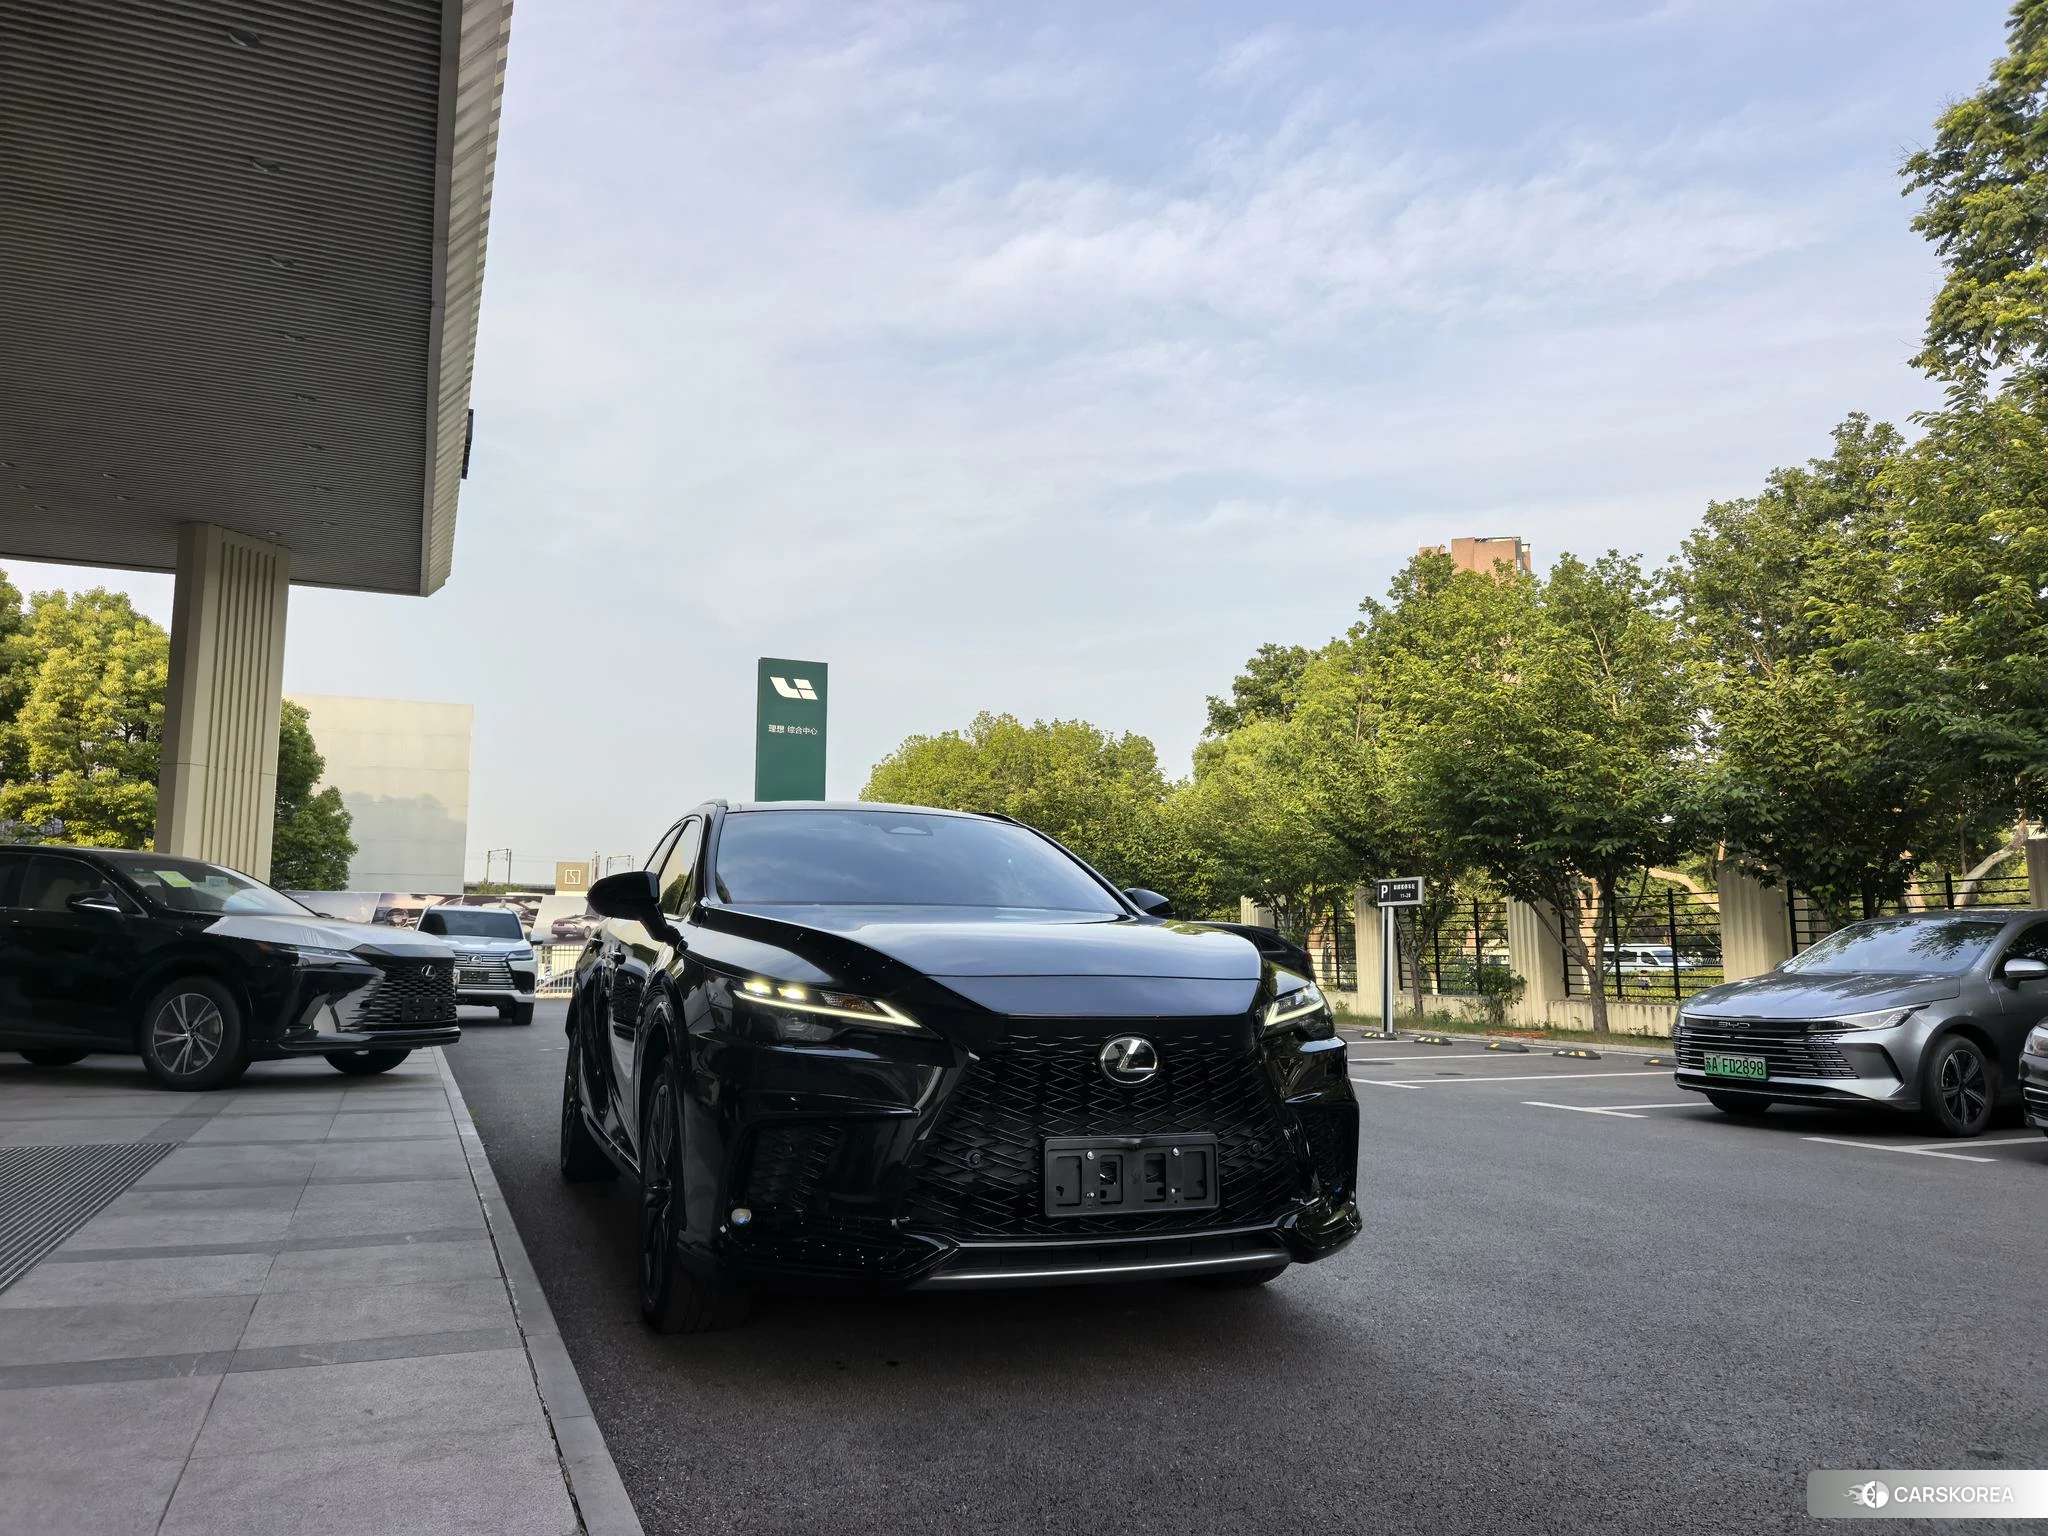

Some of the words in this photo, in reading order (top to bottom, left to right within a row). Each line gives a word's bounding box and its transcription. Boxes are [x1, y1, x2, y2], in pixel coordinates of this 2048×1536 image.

[1381, 884, 1388, 899] P
[1718, 1021, 1750, 1029] BYD
[1722, 1058, 1764, 1076] FD2898
